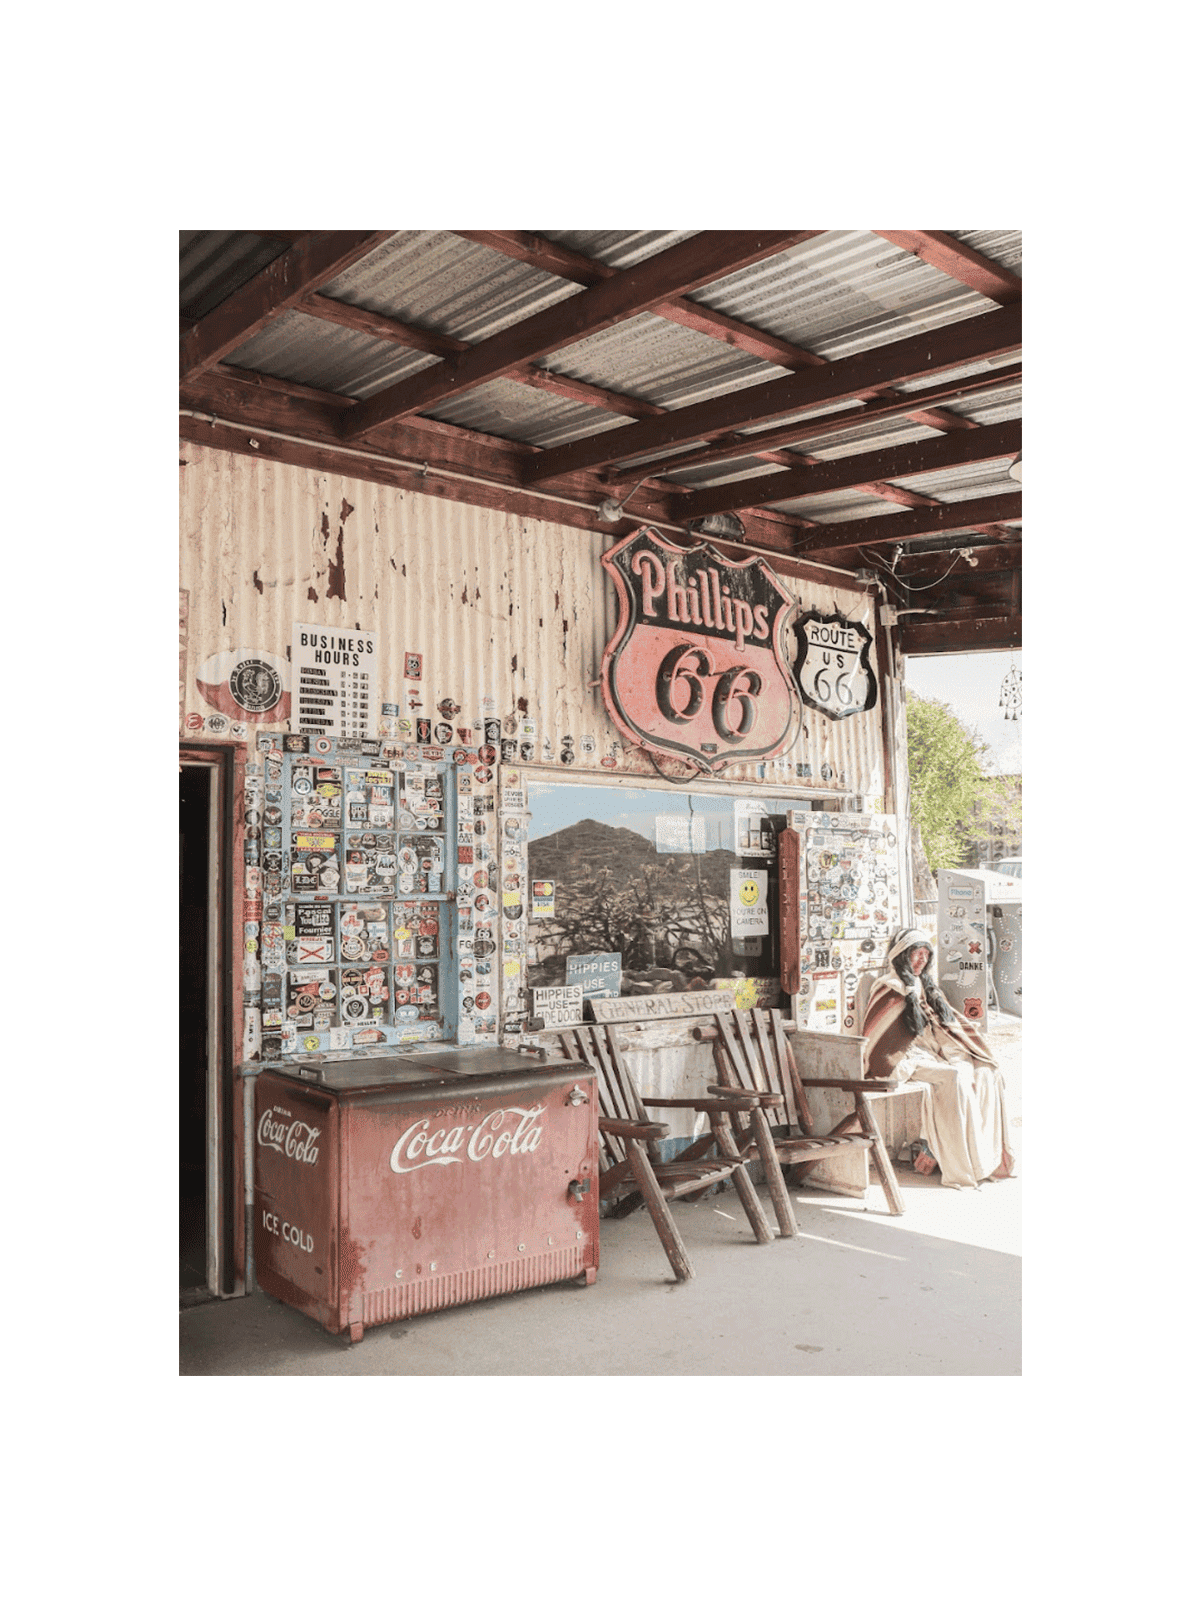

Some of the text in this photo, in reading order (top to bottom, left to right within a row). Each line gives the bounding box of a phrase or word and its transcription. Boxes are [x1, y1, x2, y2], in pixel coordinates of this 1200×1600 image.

[631, 549, 770, 652] Phillips
[300, 633, 373, 654] BUSINESS
[811, 625, 855, 650] ROUTE
[315, 649, 359, 667] HOURS
[655, 643, 768, 745] 66
[814, 668, 853, 705] 66
[736, 917, 764, 926] CAMERA
[569, 961, 618, 975] HIPPIES
[958, 961, 984, 971] DANKE
[536, 987, 581, 1001] HIPPIES
[583, 978, 605, 989] USE
[549, 1000, 569, 1010] USE
[557, 1008, 582, 1023] DOOR
[599, 997, 678, 1019] GENERAL
[257, 1109, 322, 1164] Coca-Cola
[390, 1103, 548, 1174] Coca-Cola
[263, 1210, 314, 1253] ICE COLD
